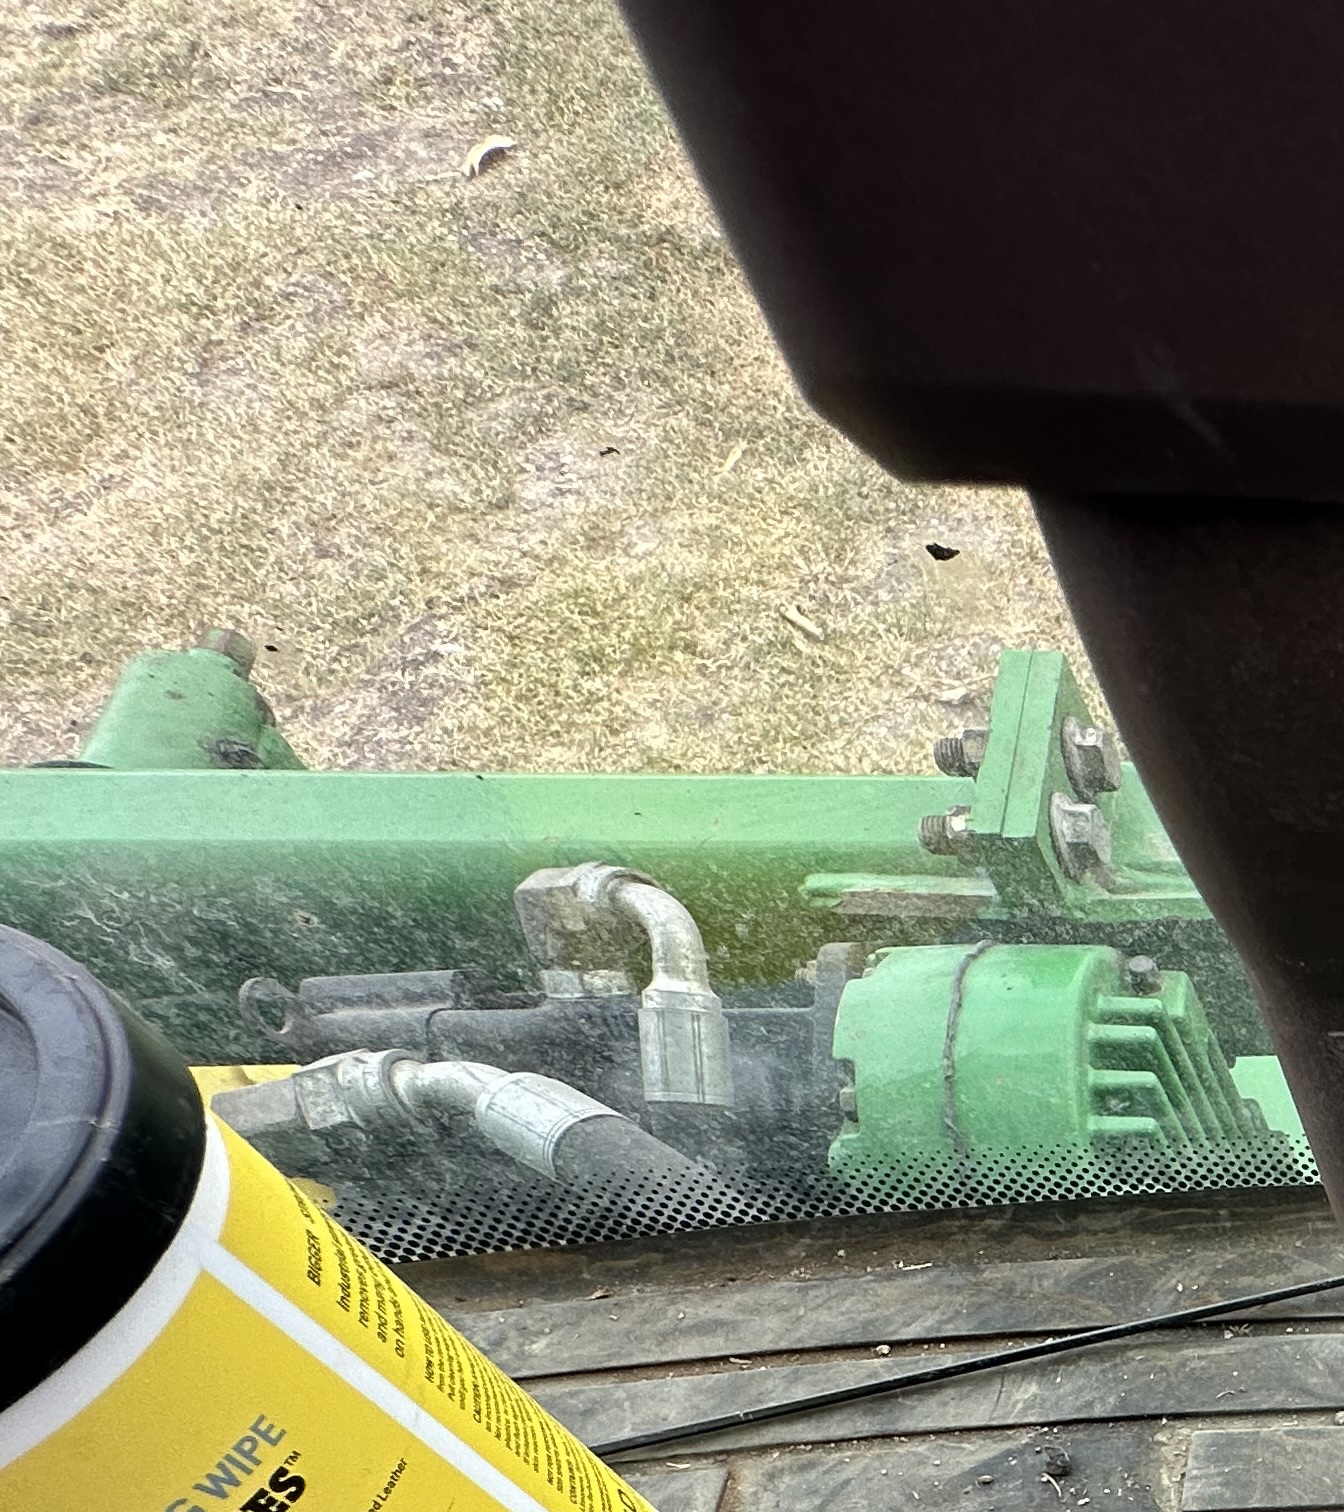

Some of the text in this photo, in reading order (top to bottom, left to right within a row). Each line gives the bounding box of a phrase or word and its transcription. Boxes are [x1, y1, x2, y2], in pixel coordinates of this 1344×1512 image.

[306, 1229, 322, 1287] BIGGER
[374, 1311, 389, 1343] and
[394, 1338, 406, 1359] on
[192, 1414, 287, 1499] WIPE
[376, 1458, 408, 1502] Leather
